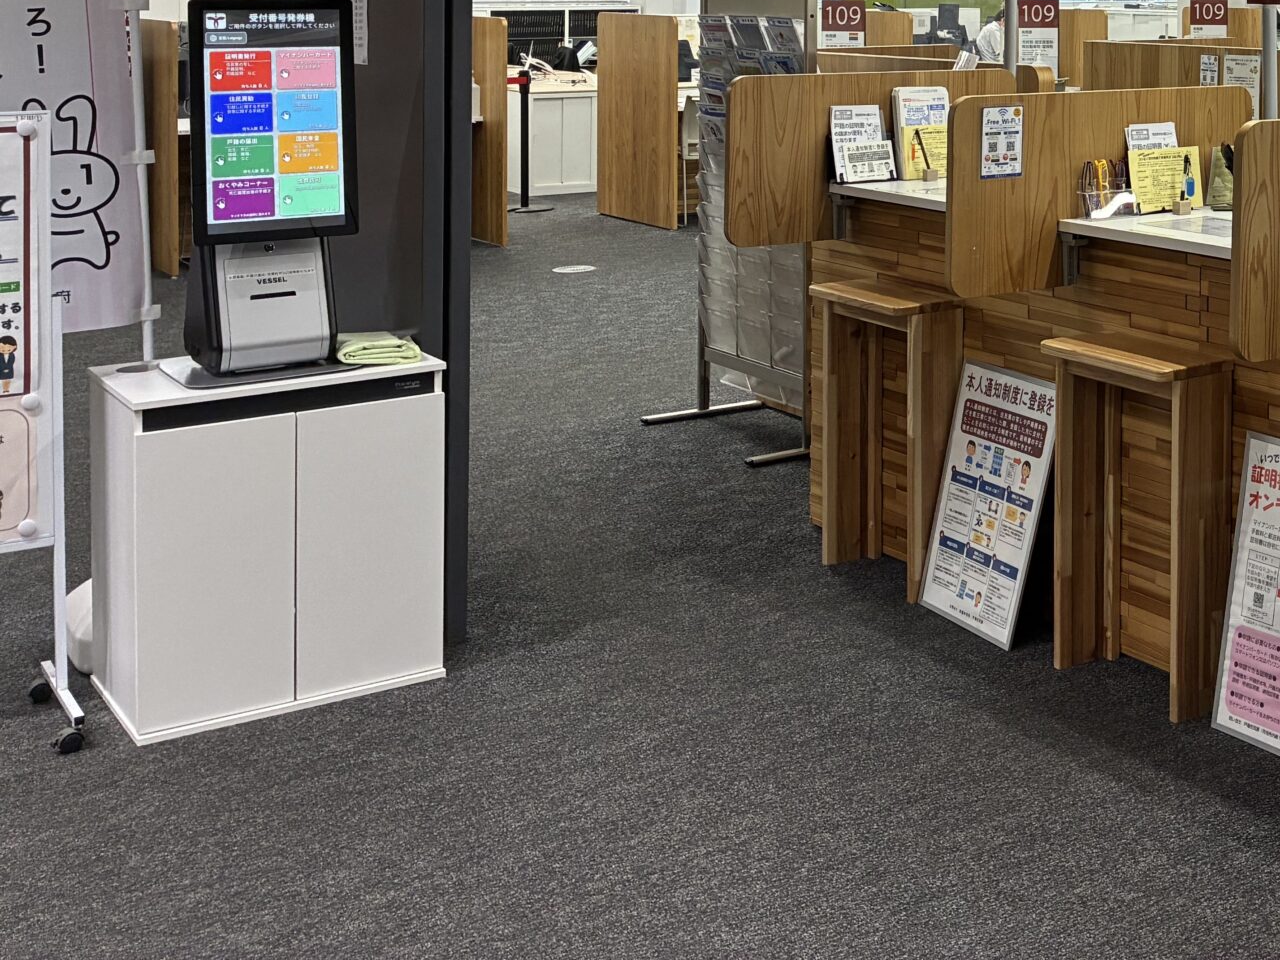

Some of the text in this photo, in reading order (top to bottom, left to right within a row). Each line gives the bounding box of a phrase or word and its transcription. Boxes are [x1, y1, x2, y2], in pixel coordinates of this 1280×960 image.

[249, 13, 315, 23] 受付番号発券機
[826, 6, 860, 25] 109
[1022, 5, 1054, 22] 109
[1194, 3, 1225, 20] 109
[257, 277, 287, 285] VESSEL
[966, 372, 1055, 416] 本人通知制度に登録を
